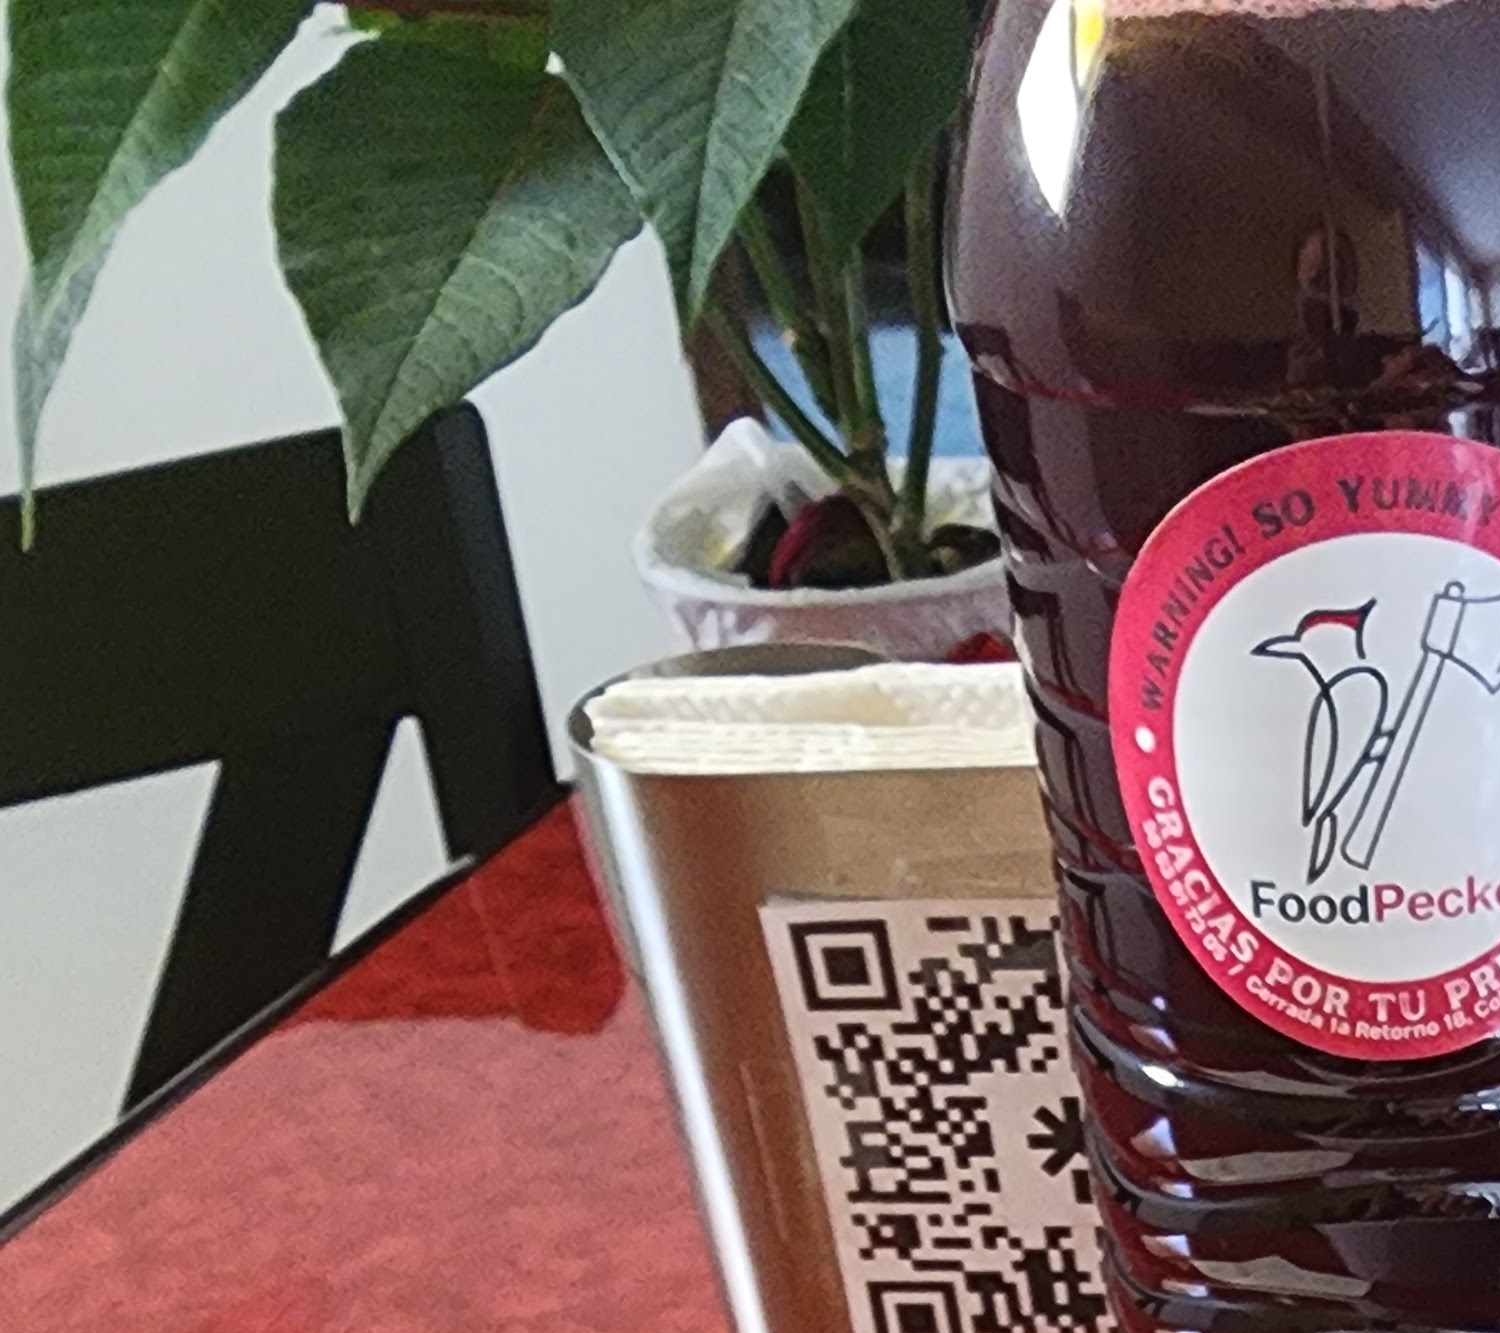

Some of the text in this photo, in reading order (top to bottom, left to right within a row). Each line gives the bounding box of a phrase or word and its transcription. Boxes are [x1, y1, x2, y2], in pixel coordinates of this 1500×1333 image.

[1141, 523, 1247, 712] WARNING!
[1252, 489, 1316, 540] SO
[1147, 775, 1260, 964] GRACIAS
[1264, 957, 1350, 1018] POR
[1368, 989, 1426, 1022] TU
[1245, 974, 1324, 1030] Cerrada
[1355, 1020, 1441, 1040] Retorno
